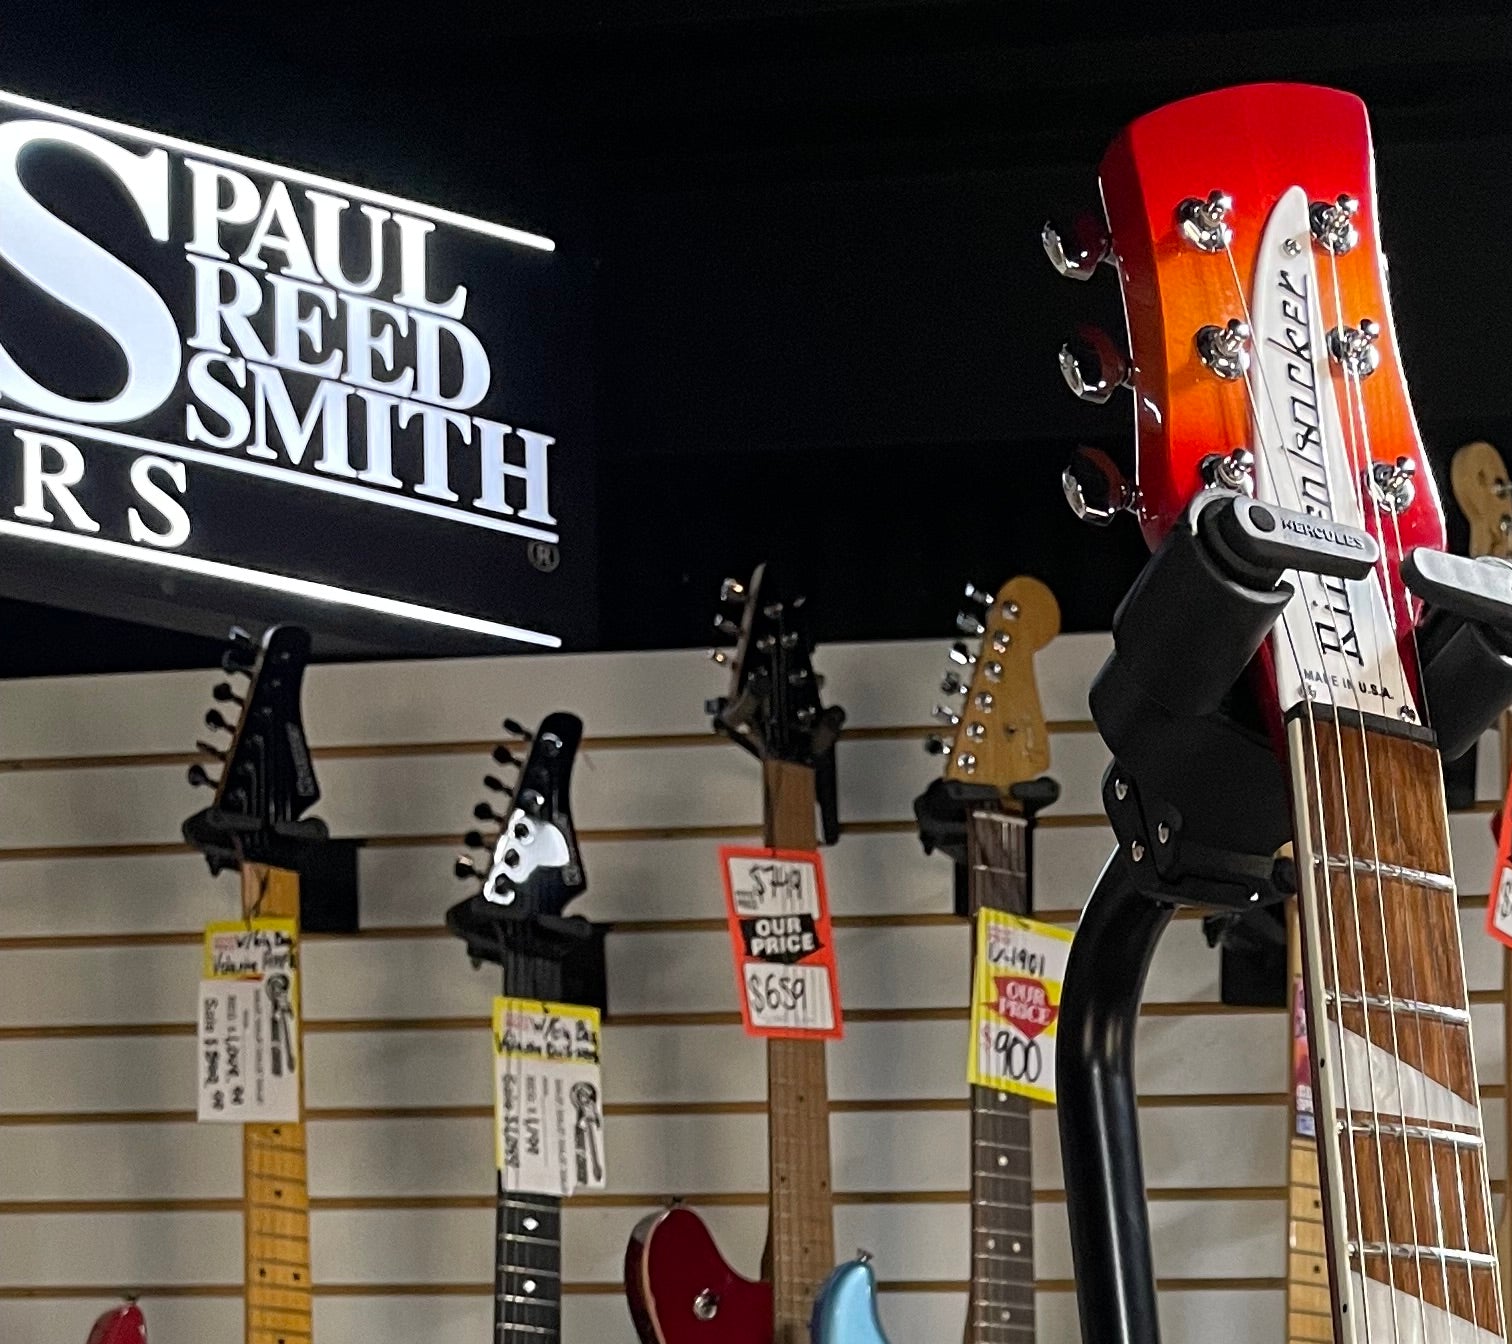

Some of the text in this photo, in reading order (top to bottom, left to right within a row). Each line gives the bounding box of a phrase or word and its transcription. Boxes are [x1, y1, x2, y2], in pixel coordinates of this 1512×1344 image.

[184, 157, 467, 320] PAUL
[185, 254, 491, 411] REED
[186, 351, 557, 526] SMITH
[1280, 516, 1365, 551] HERCULES
[750, 932, 815, 957] PRICE
[754, 916, 803, 938] OUR
[749, 973, 807, 1014] $659
[1005, 980, 1047, 1007] OUR
[998, 999, 1051, 1025] PRICE
